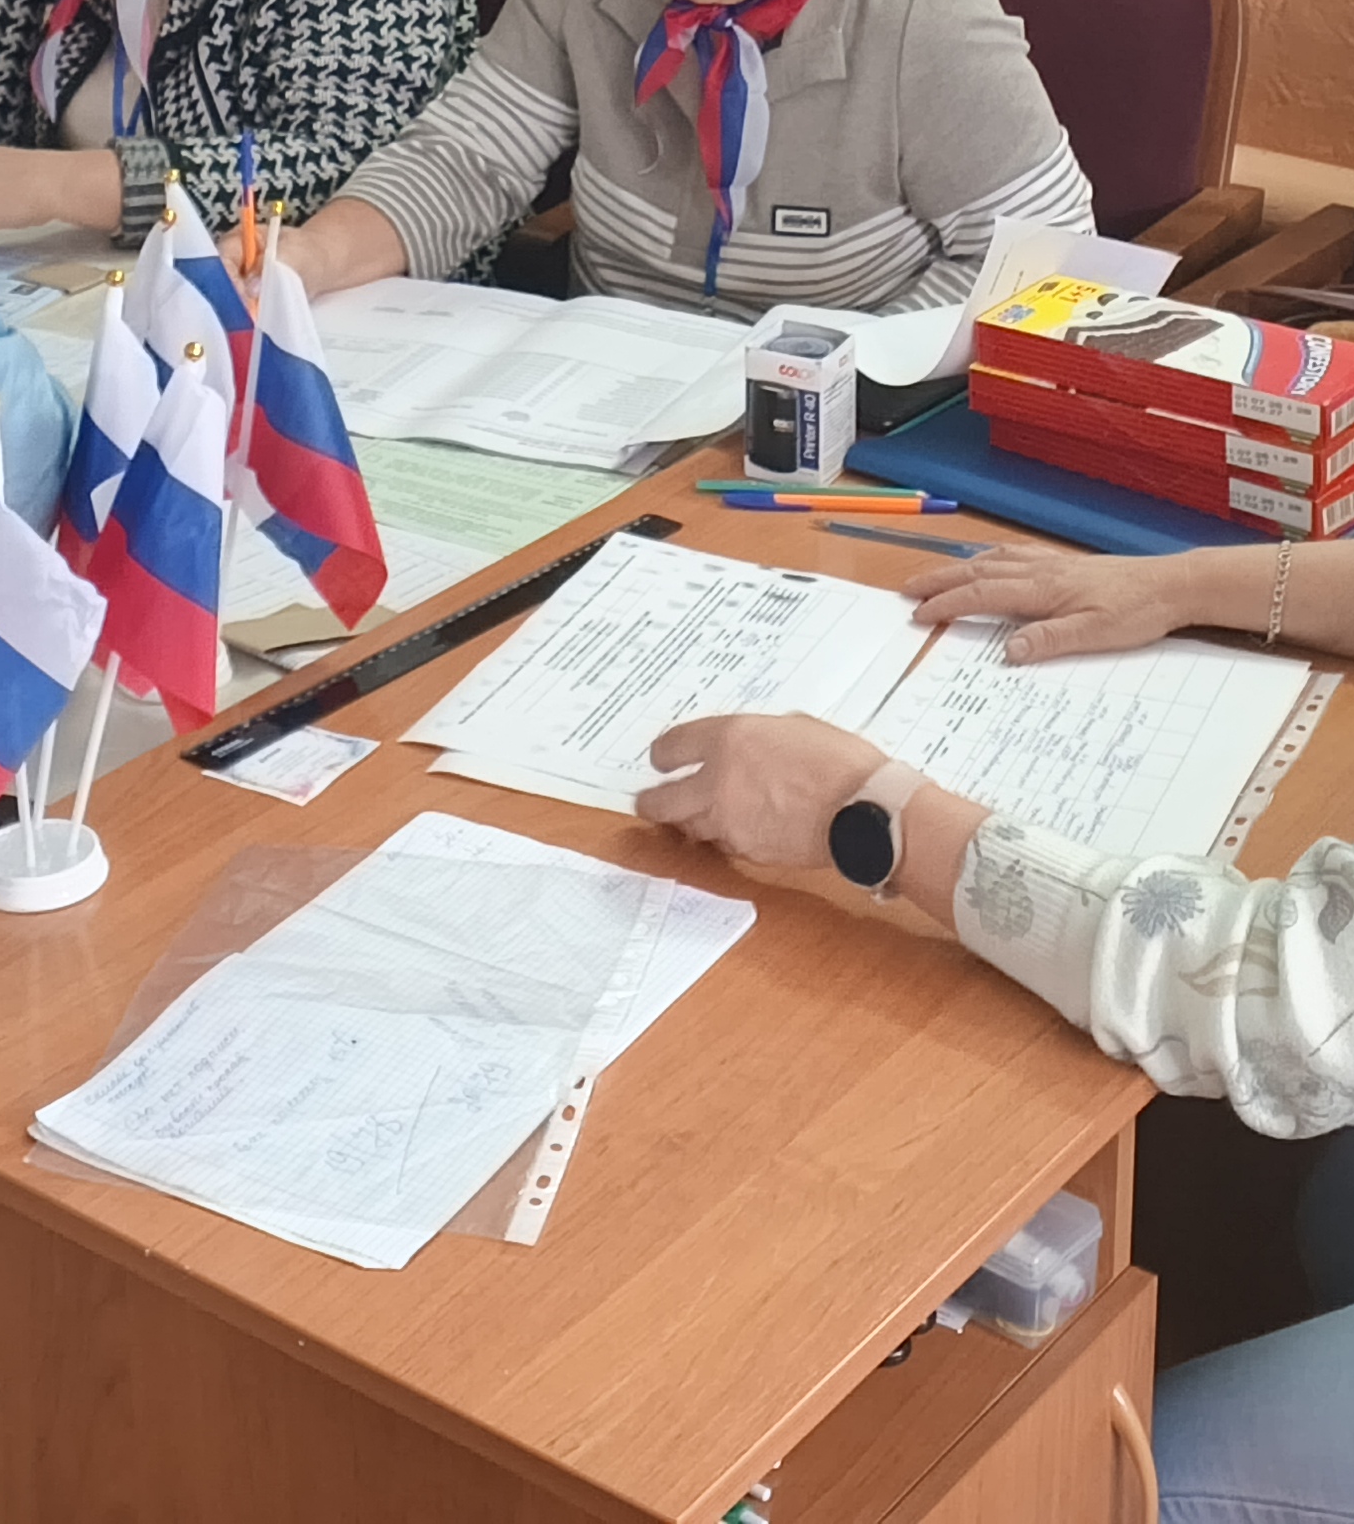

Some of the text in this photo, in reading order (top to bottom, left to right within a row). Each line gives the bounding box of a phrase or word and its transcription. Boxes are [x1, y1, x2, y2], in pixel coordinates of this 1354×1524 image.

[1290, 333, 1333, 396] CONFESTORY
[803, 393, 817, 461] Printer R 40
